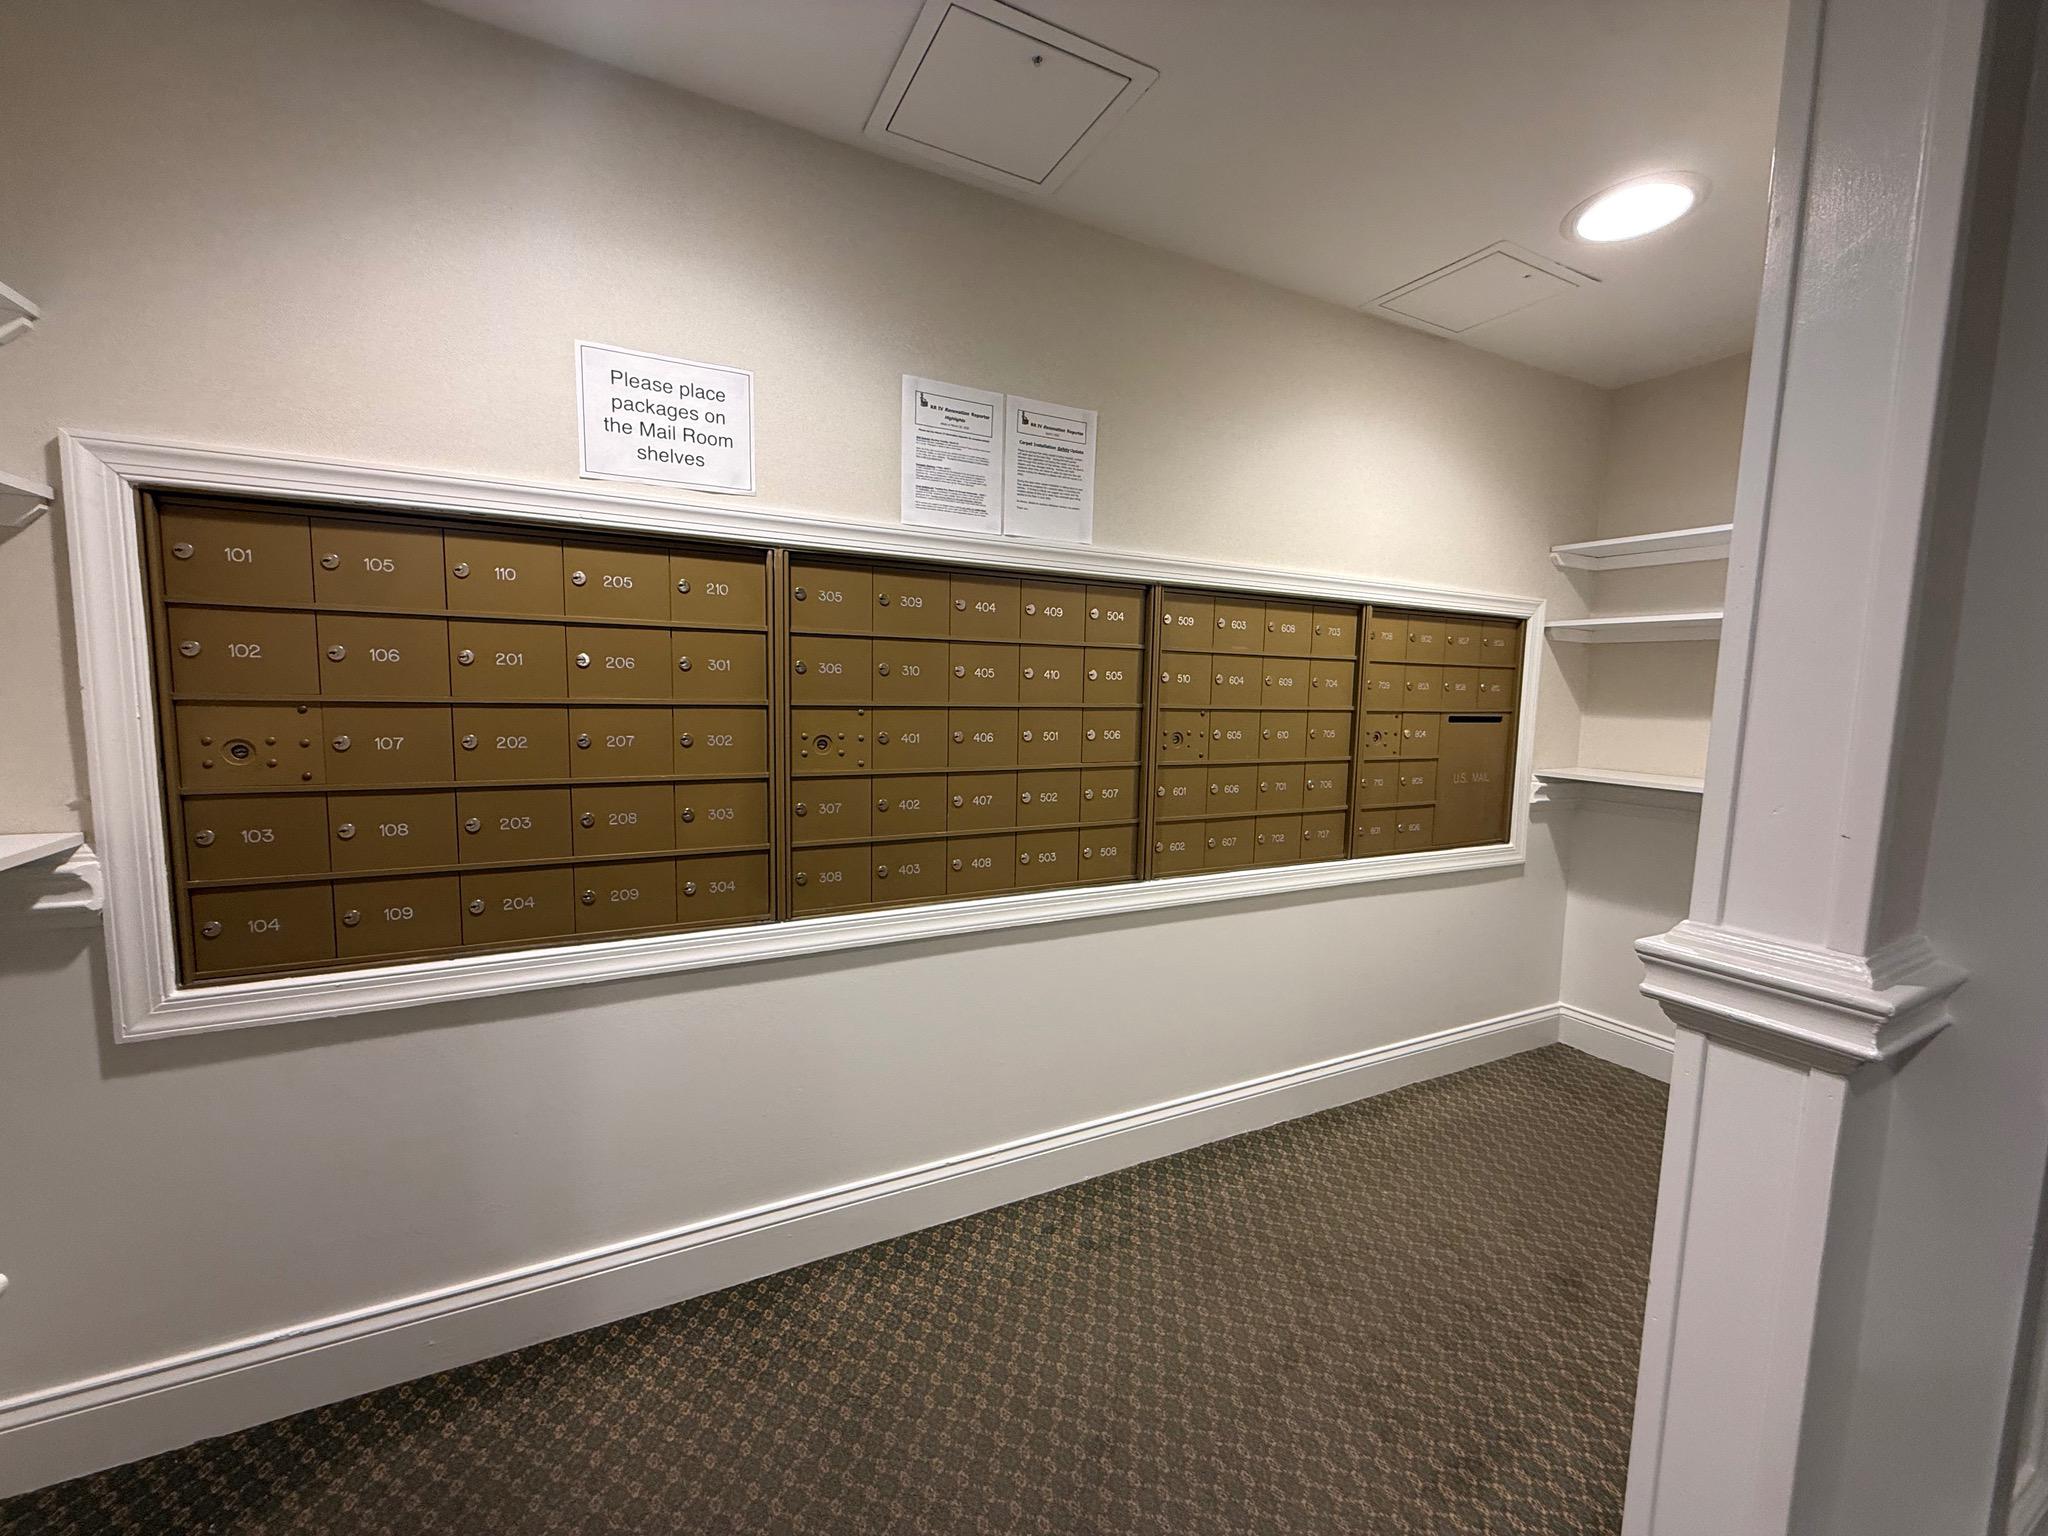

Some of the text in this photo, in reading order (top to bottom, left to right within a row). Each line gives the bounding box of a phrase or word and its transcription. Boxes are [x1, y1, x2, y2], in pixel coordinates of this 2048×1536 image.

[611, 369, 726, 402] Please place
[611, 396, 726, 425] packages on
[944, 407, 970, 416] Renovation
[971, 412, 990, 420] Reporter
[944, 415, 966, 423] Highlights
[604, 417, 734, 448] the Mail Room
[1043, 424, 1066, 433] Renovation
[1066, 428, 1084, 436] Reporter
[1019, 439, 1033, 447] Carpet
[1033, 441, 1057, 450] Installation
[637, 446, 705, 467] shelves
[225, 548, 252, 562] 101
[364, 558, 394, 572] 105
[495, 568, 516, 580] 110
[603, 575, 632, 588] 205
[707, 583, 728, 595] 210
[819, 590, 842, 602] 305
[901, 596, 922, 607] 309
[975, 602, 996, 612] 404
[1044, 607, 1063, 617] 409
[1107, 612, 1124, 621] 504
[1178, 616, 1194, 627] 509
[1231, 620, 1247, 630] 603
[1281, 624, 1296, 633] 608
[1328, 628, 1341, 636] 703
[228, 644, 261, 658] 102
[370, 649, 400, 662] 106
[496, 653, 522, 665] 201
[606, 657, 634, 669] 206
[708, 659, 730, 671] 301
[818, 663, 842, 673] 306
[902, 665, 919, 676] 310
[975, 668, 994, 678] 405
[1044, 670, 1060, 679] 410
[1106, 671, 1122, 680] 505
[1177, 674, 1191, 684] 510
[1229, 675, 1244, 685] 604
[1278, 677, 1293, 686] 609
[1325, 678, 1338, 688] 704
[901, 734, 919, 743] 401
[974, 733, 993, 742] 406
[1043, 732, 1058, 741] 501
[1104, 730, 1120, 739] 506
[1227, 730, 1242, 740] 605
[1277, 730, 1289, 739] 610
[1322, 730, 1336, 738] 705
[375, 737, 404, 750] 107
[497, 736, 527, 748] 202
[607, 736, 634, 747] 207
[707, 735, 733, 746] 302
[1453, 772, 1489, 784] U.S. MAIL
[1224, 784, 1239, 793] 606
[1275, 782, 1287, 791] 701
[1320, 780, 1332, 788] 706
[1040, 793, 1057, 802] 502
[1102, 789, 1118, 798] 507
[1173, 787, 1187, 797] 601
[899, 800, 920, 809] 402
[973, 795, 992, 805] 407
[708, 808, 734, 820] 303
[819, 803, 842, 814] 307
[500, 817, 531, 830] 203
[609, 813, 637, 825] 208
[379, 824, 408, 836] 108
[1317, 830, 1330, 839] 707
[242, 829, 274, 843] 103
[1271, 834, 1284, 843] 702
[1169, 842, 1185, 852] 602
[1222, 837, 1237, 847] 607
[1100, 847, 1116, 856] 508
[972, 858, 991, 868] 408
[1039, 852, 1056, 863] 503
[899, 864, 920, 874] 403
[819, 871, 842, 883] 308
[709, 881, 735, 893] 304
[611, 889, 639, 901] 209
[504, 897, 535, 910] 204
[384, 907, 413, 920] 109
[248, 918, 280, 932] 104
